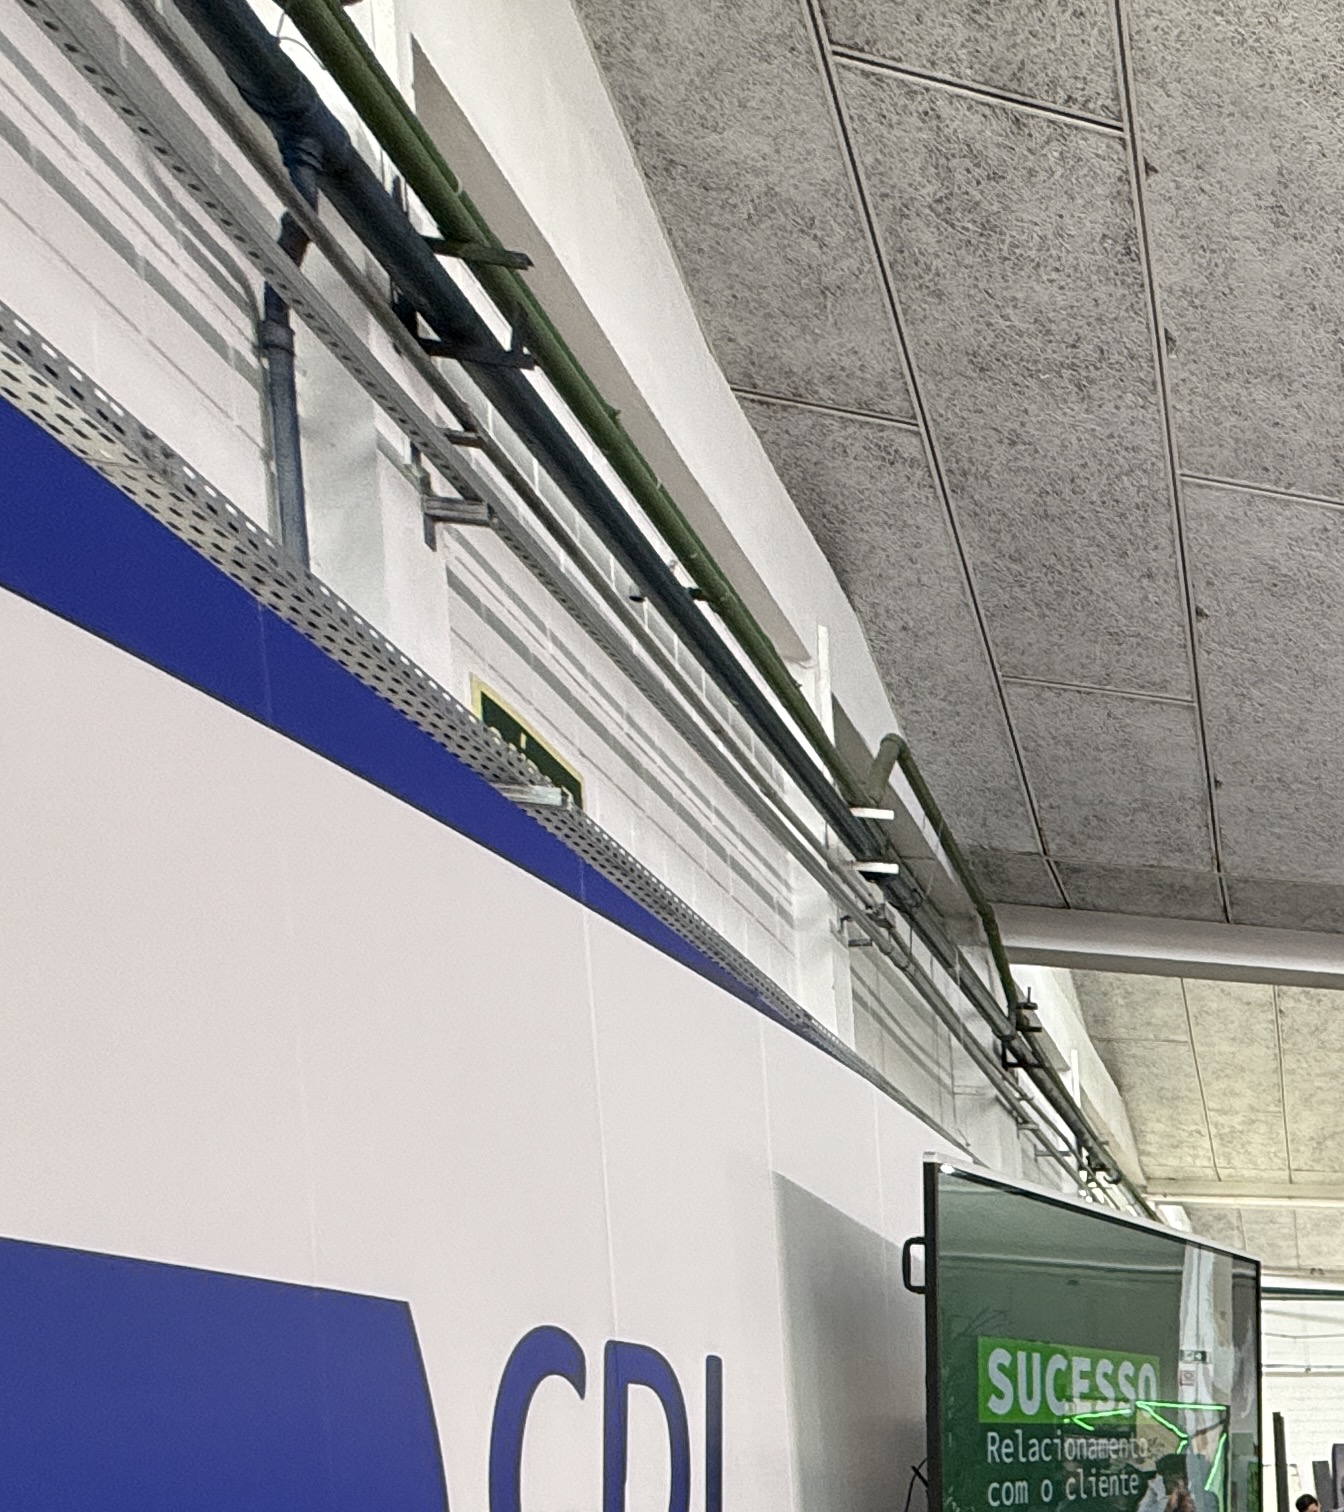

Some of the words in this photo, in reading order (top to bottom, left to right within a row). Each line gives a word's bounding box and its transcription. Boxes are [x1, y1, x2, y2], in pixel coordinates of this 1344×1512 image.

[987, 1347, 1157, 1417] SUCESSO
[987, 1428, 1148, 1463] Relacionamento
[987, 1479, 1029, 1507] com
[1040, 1478, 1053, 1503] o
[1065, 1467, 1139, 1500] cliente
